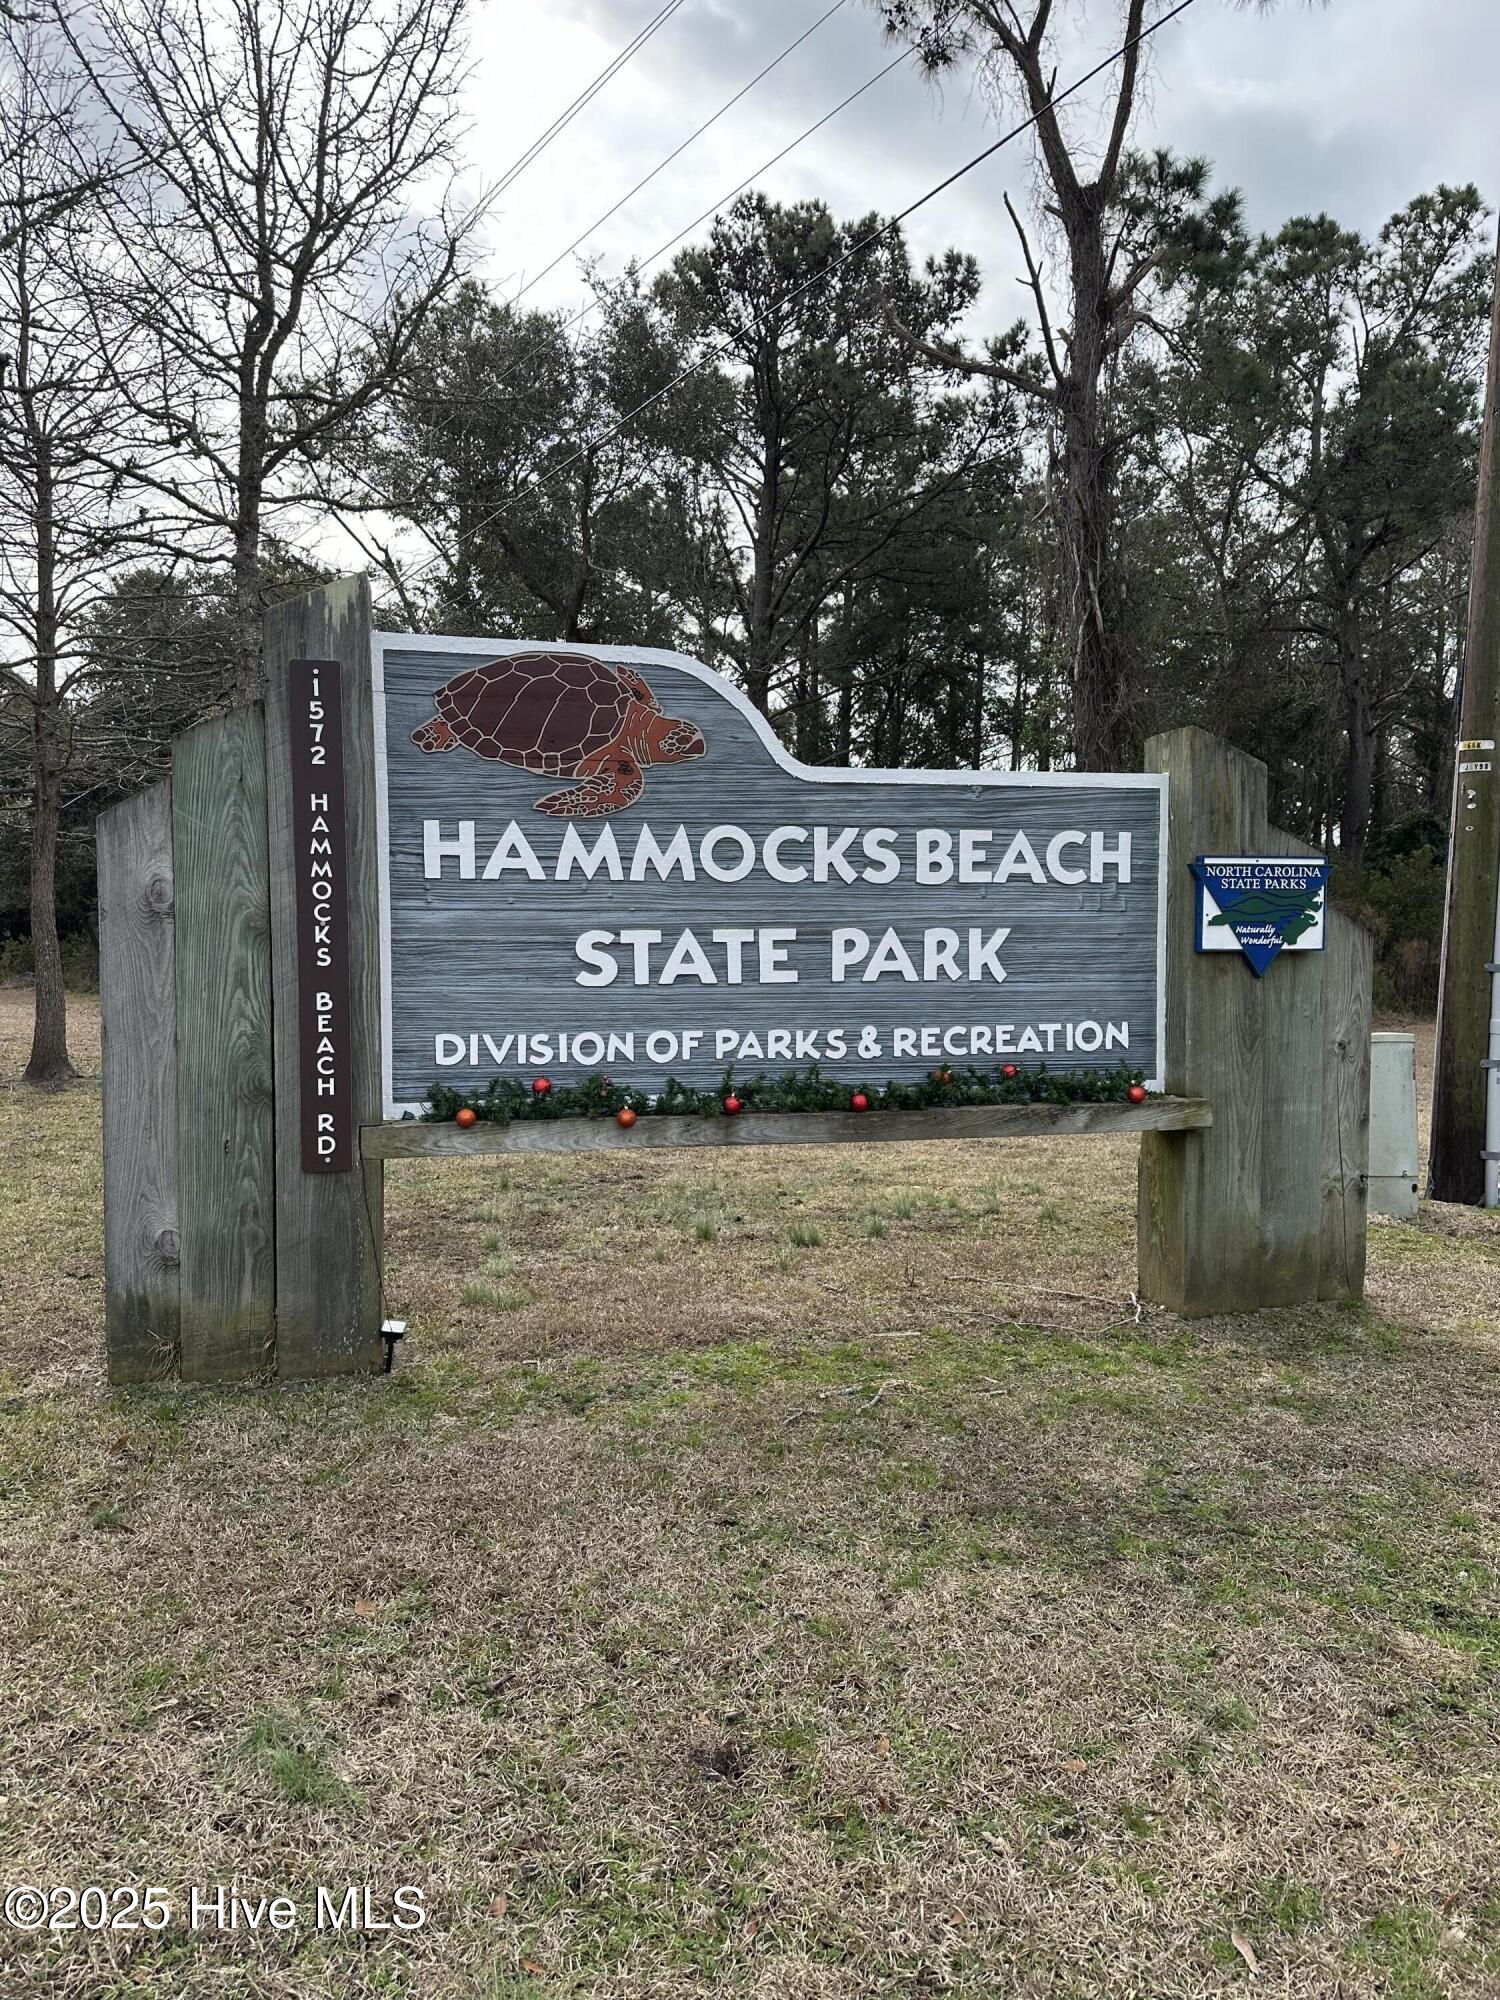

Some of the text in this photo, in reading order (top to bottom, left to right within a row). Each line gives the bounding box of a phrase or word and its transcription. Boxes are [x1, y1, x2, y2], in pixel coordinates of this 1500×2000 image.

[423, 819, 1132, 885] HAMMOCKS BEACH
[1206, 865, 1321, 878] NORTH CAROLINA
[309, 793, 333, 967] HAMMOCKS
[1221, 878, 1307, 890] STATE PARKS
[1235, 924, 1275, 938] Naturally
[1240, 935, 1283, 949] Wonderful
[574, 926, 1011, 987] STATE PARK
[316, 991, 335, 1096] BEACH
[435, 1020, 1129, 1066] DIVISION OF PARKS & RECREATION
